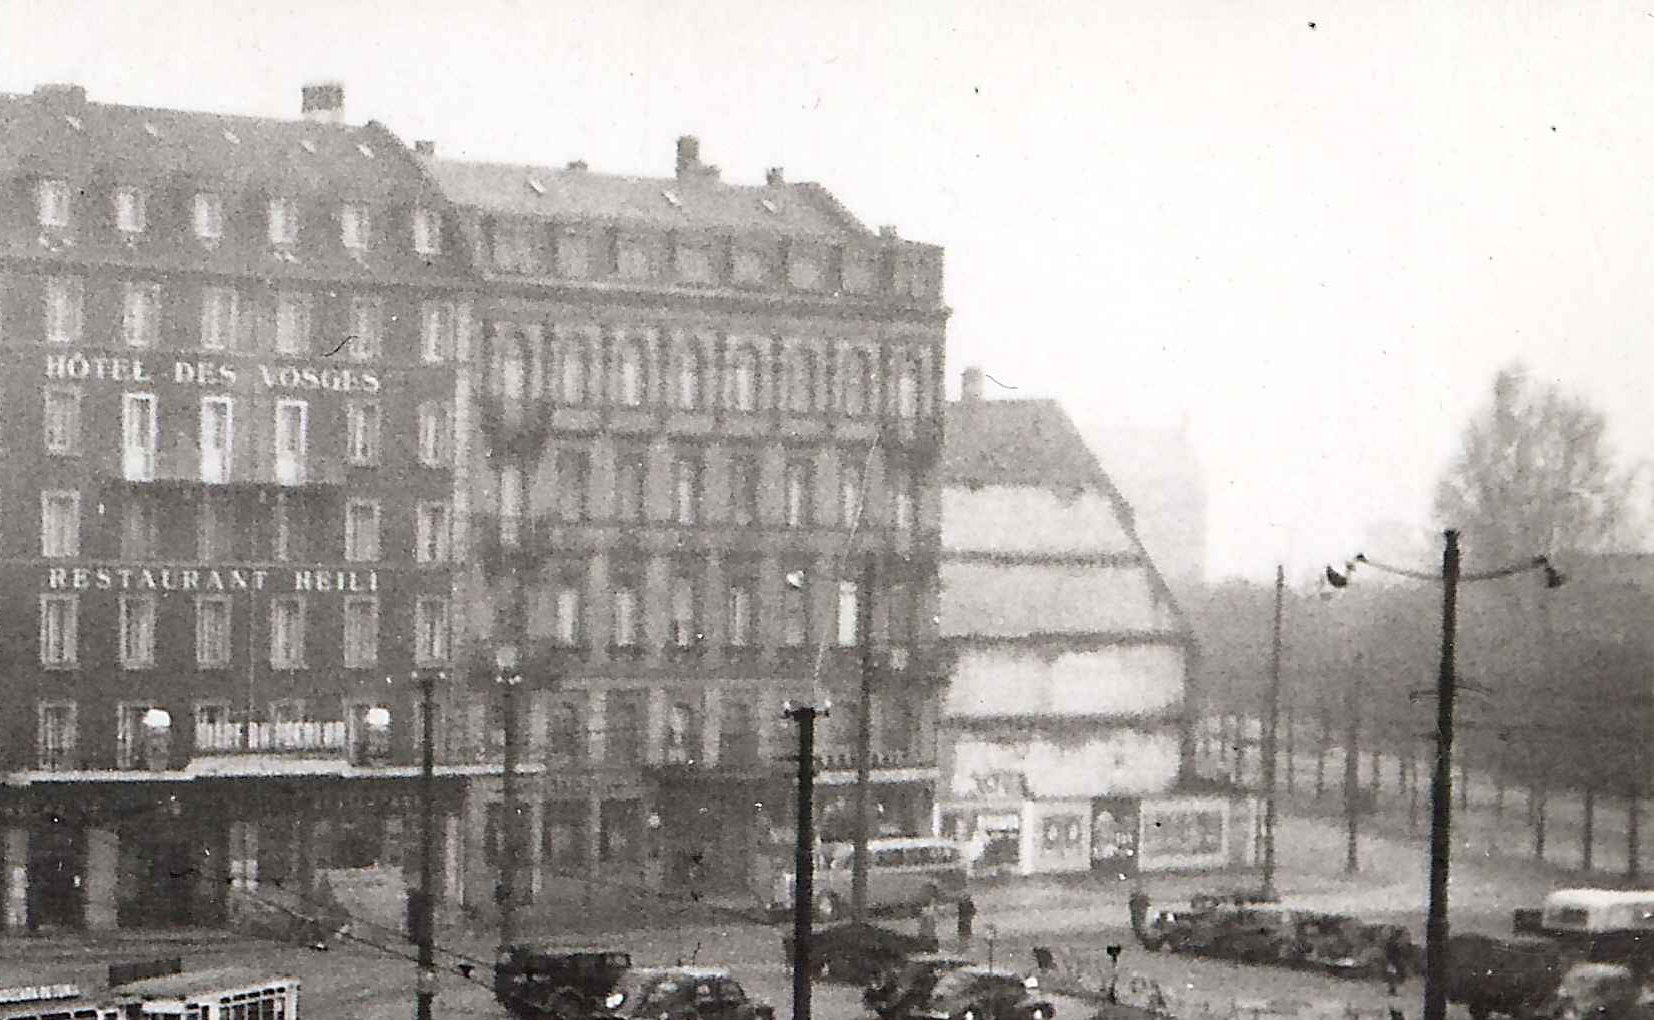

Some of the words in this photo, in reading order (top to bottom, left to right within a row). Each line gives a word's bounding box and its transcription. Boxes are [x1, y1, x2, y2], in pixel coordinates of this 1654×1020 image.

[45, 351, 151, 382] HÔTEL
[174, 361, 237, 385] DES
[259, 364, 381, 393] VOSGES
[48, 567, 268, 591] RESTAURANT
